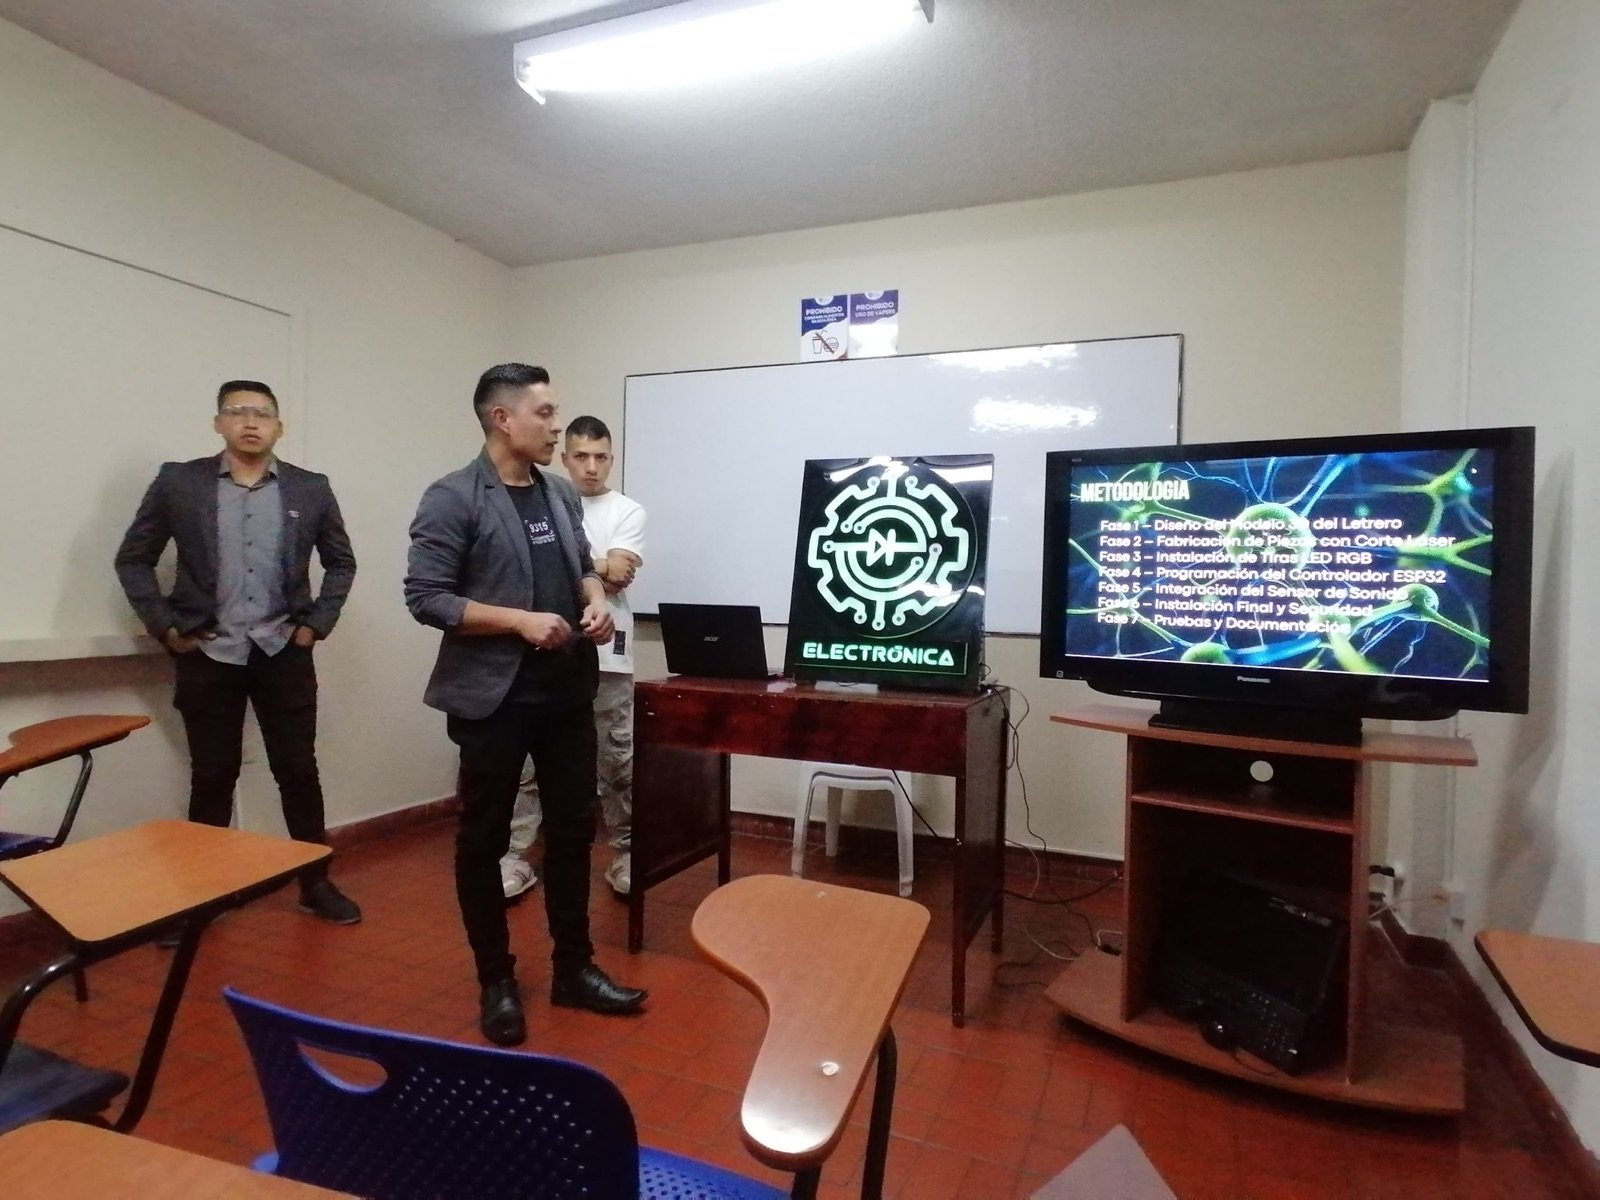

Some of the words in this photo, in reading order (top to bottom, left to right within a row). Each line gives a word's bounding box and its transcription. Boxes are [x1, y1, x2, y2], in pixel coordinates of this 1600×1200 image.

[805, 305, 843, 316] PROHIBIDO
[855, 301, 894, 311] PROHIBIDO
[1080, 480, 1190, 502] METODOLOGIA
[1100, 520, 1131, 531] Fase
[1133, 520, 1139, 531] 1
[1154, 519, 1203, 531] Diseño
[1204, 518, 1226, 531] del
[1312, 517, 1338, 530] del
[1341, 517, 1403, 530] Letrero
[1099, 535, 1131, 547] Fase
[1133, 535, 1142, 547] 2
[1244, 535, 1264, 547] de
[1267, 535, 1317, 547] Piezas
[1319, 536, 1351, 547] con
[1354, 534, 1403, 547] Corte
[1099, 551, 1131, 563] Fase
[1132, 551, 1142, 562] 3
[1156, 551, 1236, 563] Instalación
[1238, 553, 1257, 564] de
[1262, 552, 1298, 564] Tiras
[1336, 552, 1373, 564] RGB
[1099, 566, 1130, 578] Fase
[1131, 566, 1141, 577] 4
[1156, 566, 1258, 581] Programación
[1260, 568, 1286, 580] del
[1289, 569, 1390, 582] Controlador
[1393, 570, 1447, 583] ESP32
[1098, 582, 1130, 593] Fase
[1131, 582, 1141, 593] 5
[1155, 583, 1237, 597] Integración
[1240, 585, 1264, 597] del
[1267, 586, 1322, 598] Sensor
[1324, 587, 1348, 599] de
[1350, 587, 1408, 600] Sonido
[1097, 596, 1129, 609] Fase
[1131, 597, 1140, 609] 6
[1155, 599, 1233, 612] Instalación
[1236, 601, 1273, 613] Final
[1276, 604, 1286, 616] y
[1097, 612, 1129, 624] Fase
[1131, 613, 1139, 625] 7
[1154, 614, 1212, 628] Pruebas
[1213, 617, 1223, 631] y
[803, 641, 955, 666] ELECTRÓNICA
